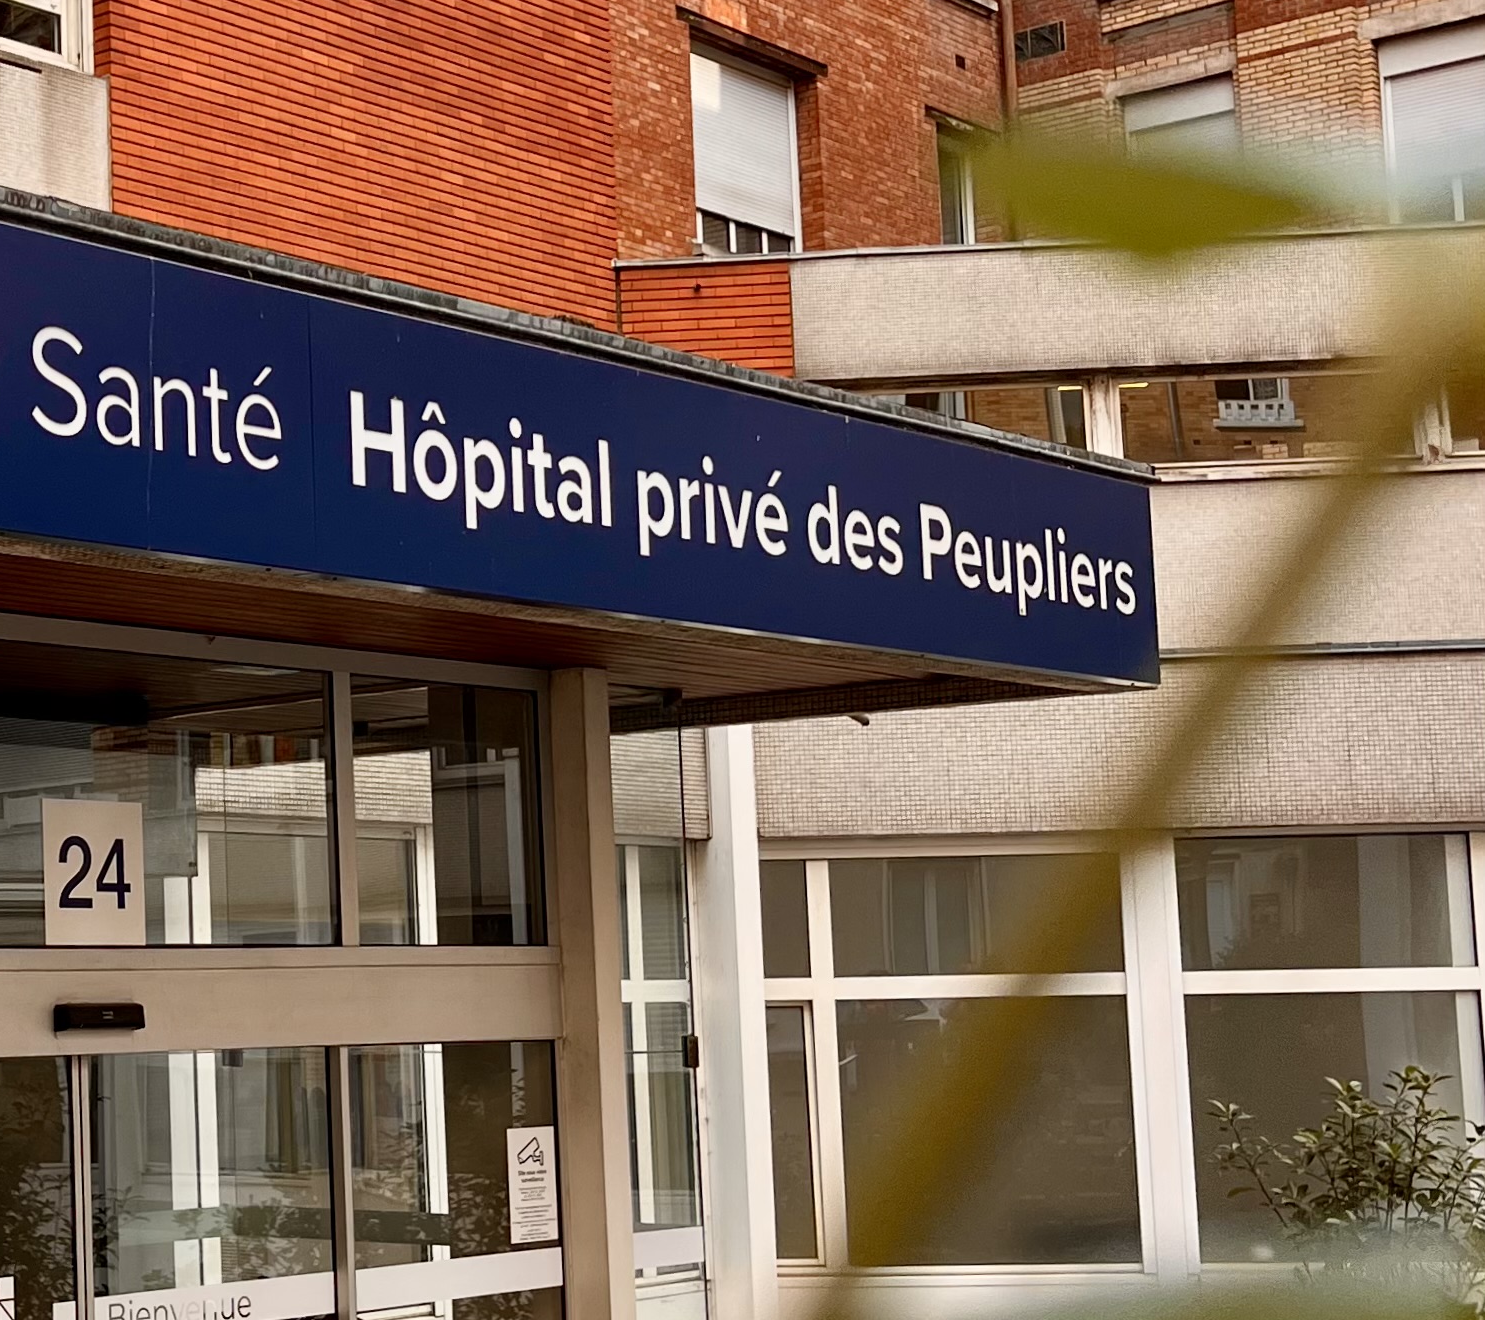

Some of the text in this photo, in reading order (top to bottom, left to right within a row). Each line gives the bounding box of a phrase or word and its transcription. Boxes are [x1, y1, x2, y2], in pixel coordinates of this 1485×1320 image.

[31, 326, 282, 472] Santé
[349, 391, 613, 530] Hôpital
[637, 455, 789, 558] privé
[807, 485, 904, 576] des
[920, 504, 1137, 617] Peupliers
[57, 835, 131, 909] 24
